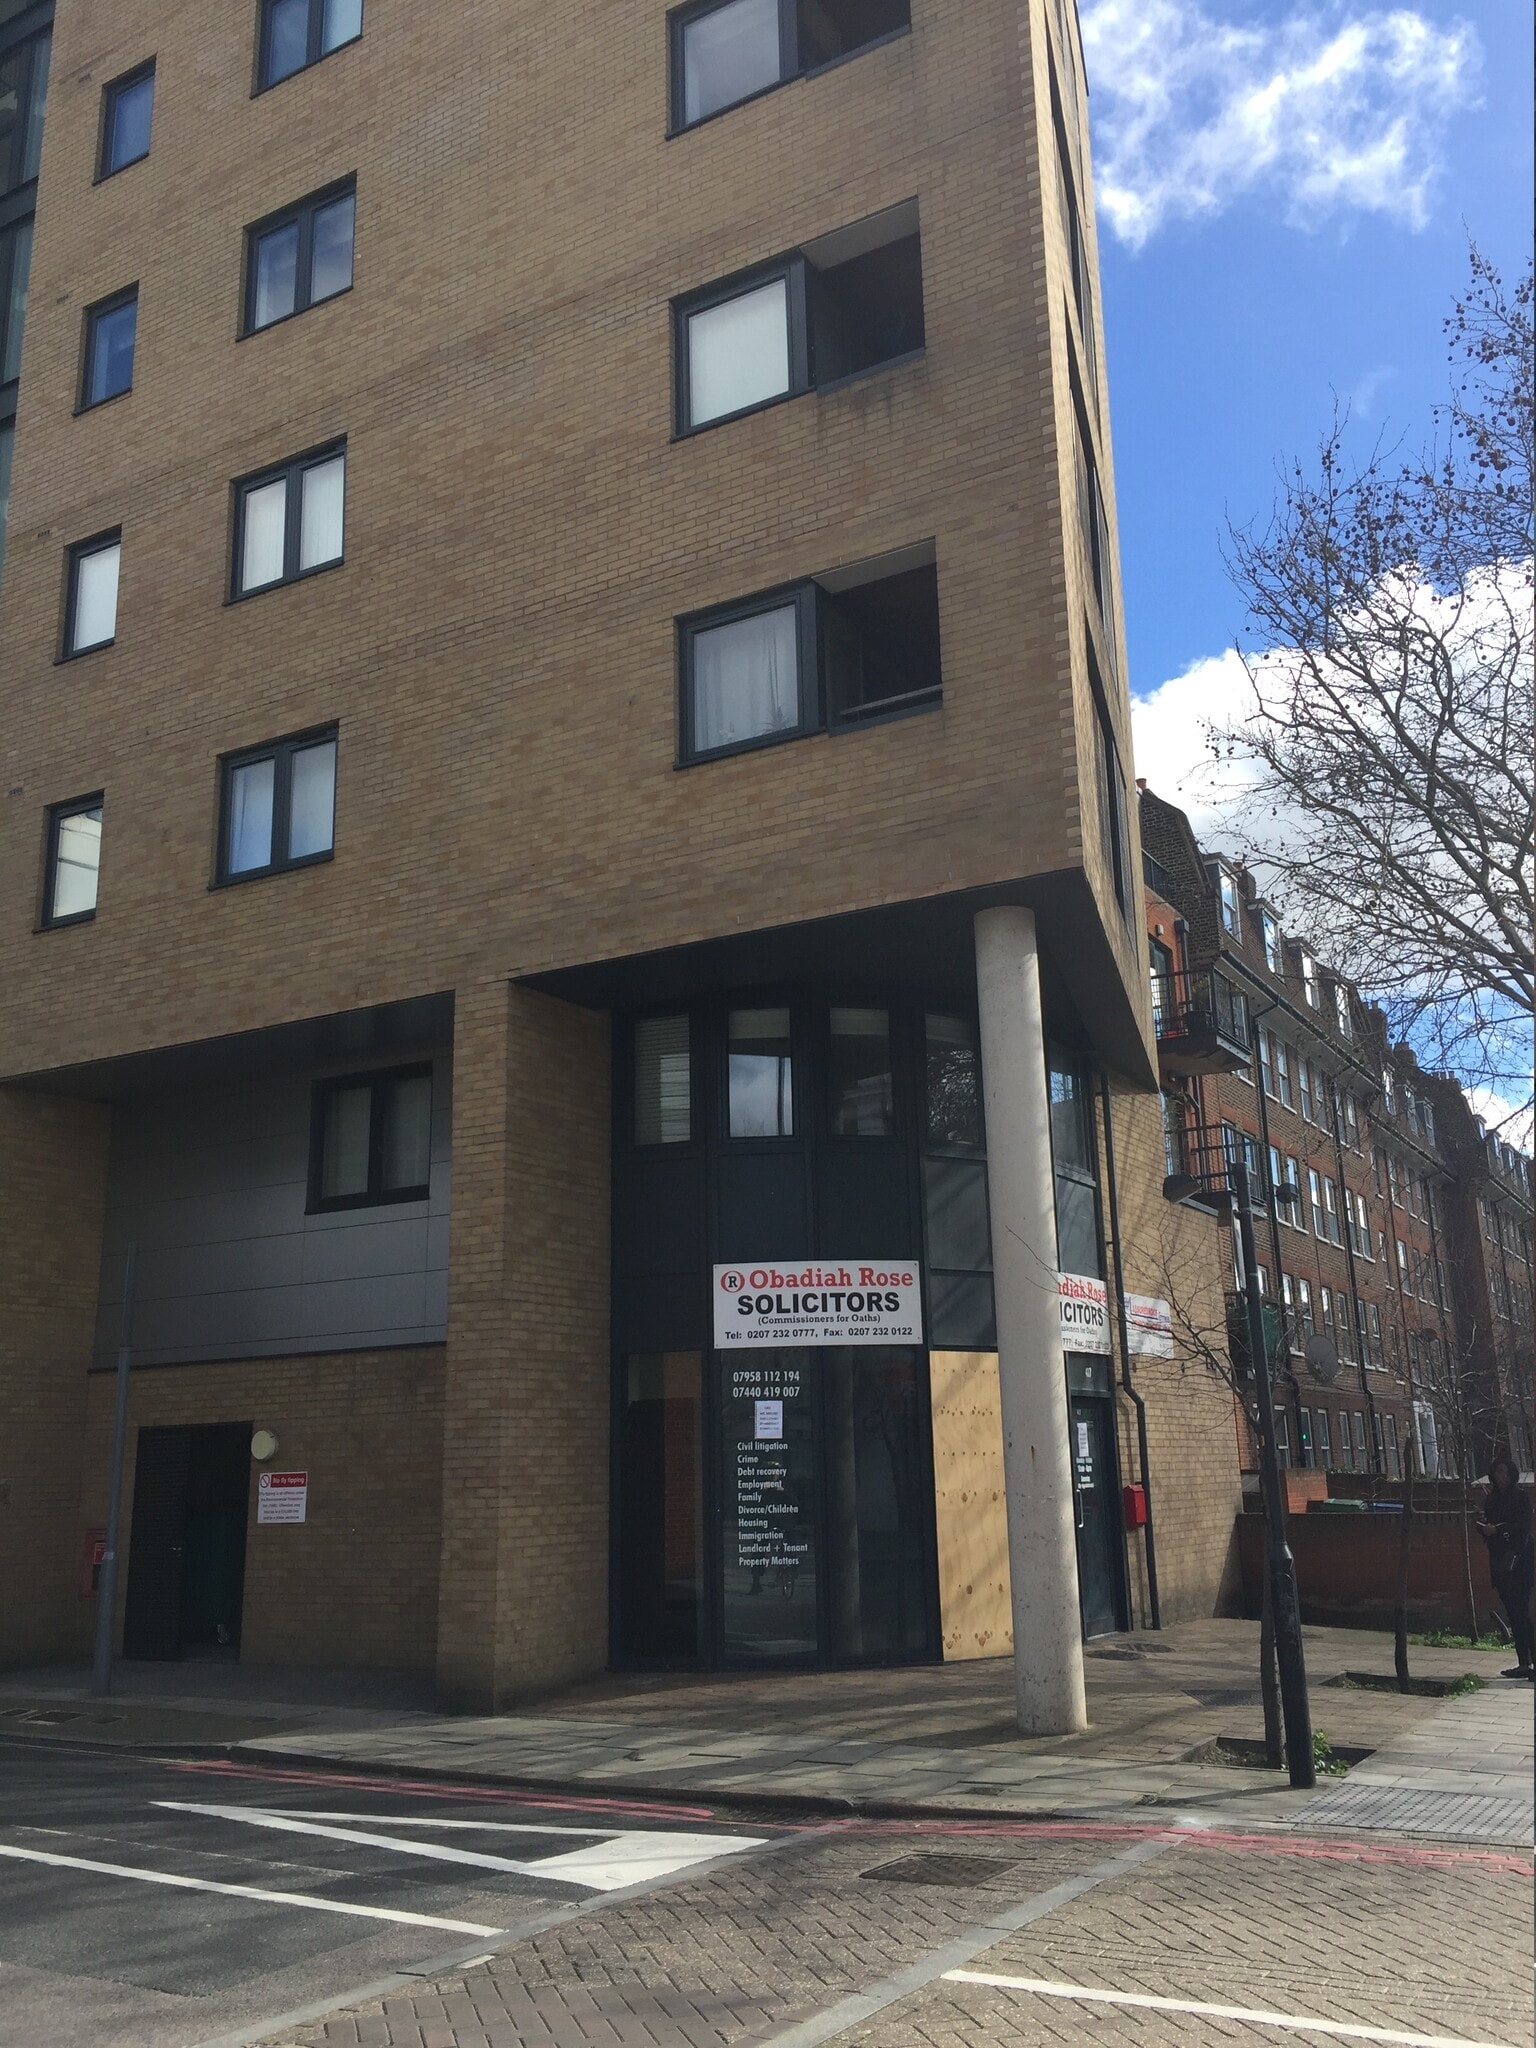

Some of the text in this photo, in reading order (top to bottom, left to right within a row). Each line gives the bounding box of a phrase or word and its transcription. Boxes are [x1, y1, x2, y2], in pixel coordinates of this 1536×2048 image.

[749, 1267, 914, 1289] Obadiah Rose
[1087, 1281, 1107, 1302] Rose
[737, 1292, 900, 1315] SOLICITORS
[758, 1313, 881, 1325] (Commissioners for Oaths)
[725, 1327, 913, 1340] Tel: 0207 232 0777, Fax: 0207 232 0122
[733, 1370, 800, 1382] 07958 112 194
[733, 1386, 800, 1398] 07440 419 007
[737, 1441, 788, 1452] Civil litigation
[737, 1454, 759, 1463] Crime
[737, 1467, 787, 1477] Debt recovery
[738, 1480, 783, 1490] Employment
[738, 1493, 762, 1503] Family
[738, 1505, 799, 1514] Divorce/Children
[738, 1518, 768, 1529] Housing
[738, 1531, 784, 1542] Immigration
[738, 1544, 771, 1553] Landlord
[783, 1543, 808, 1552] Tenant
[738, 1556, 800, 1567] Property Matters
